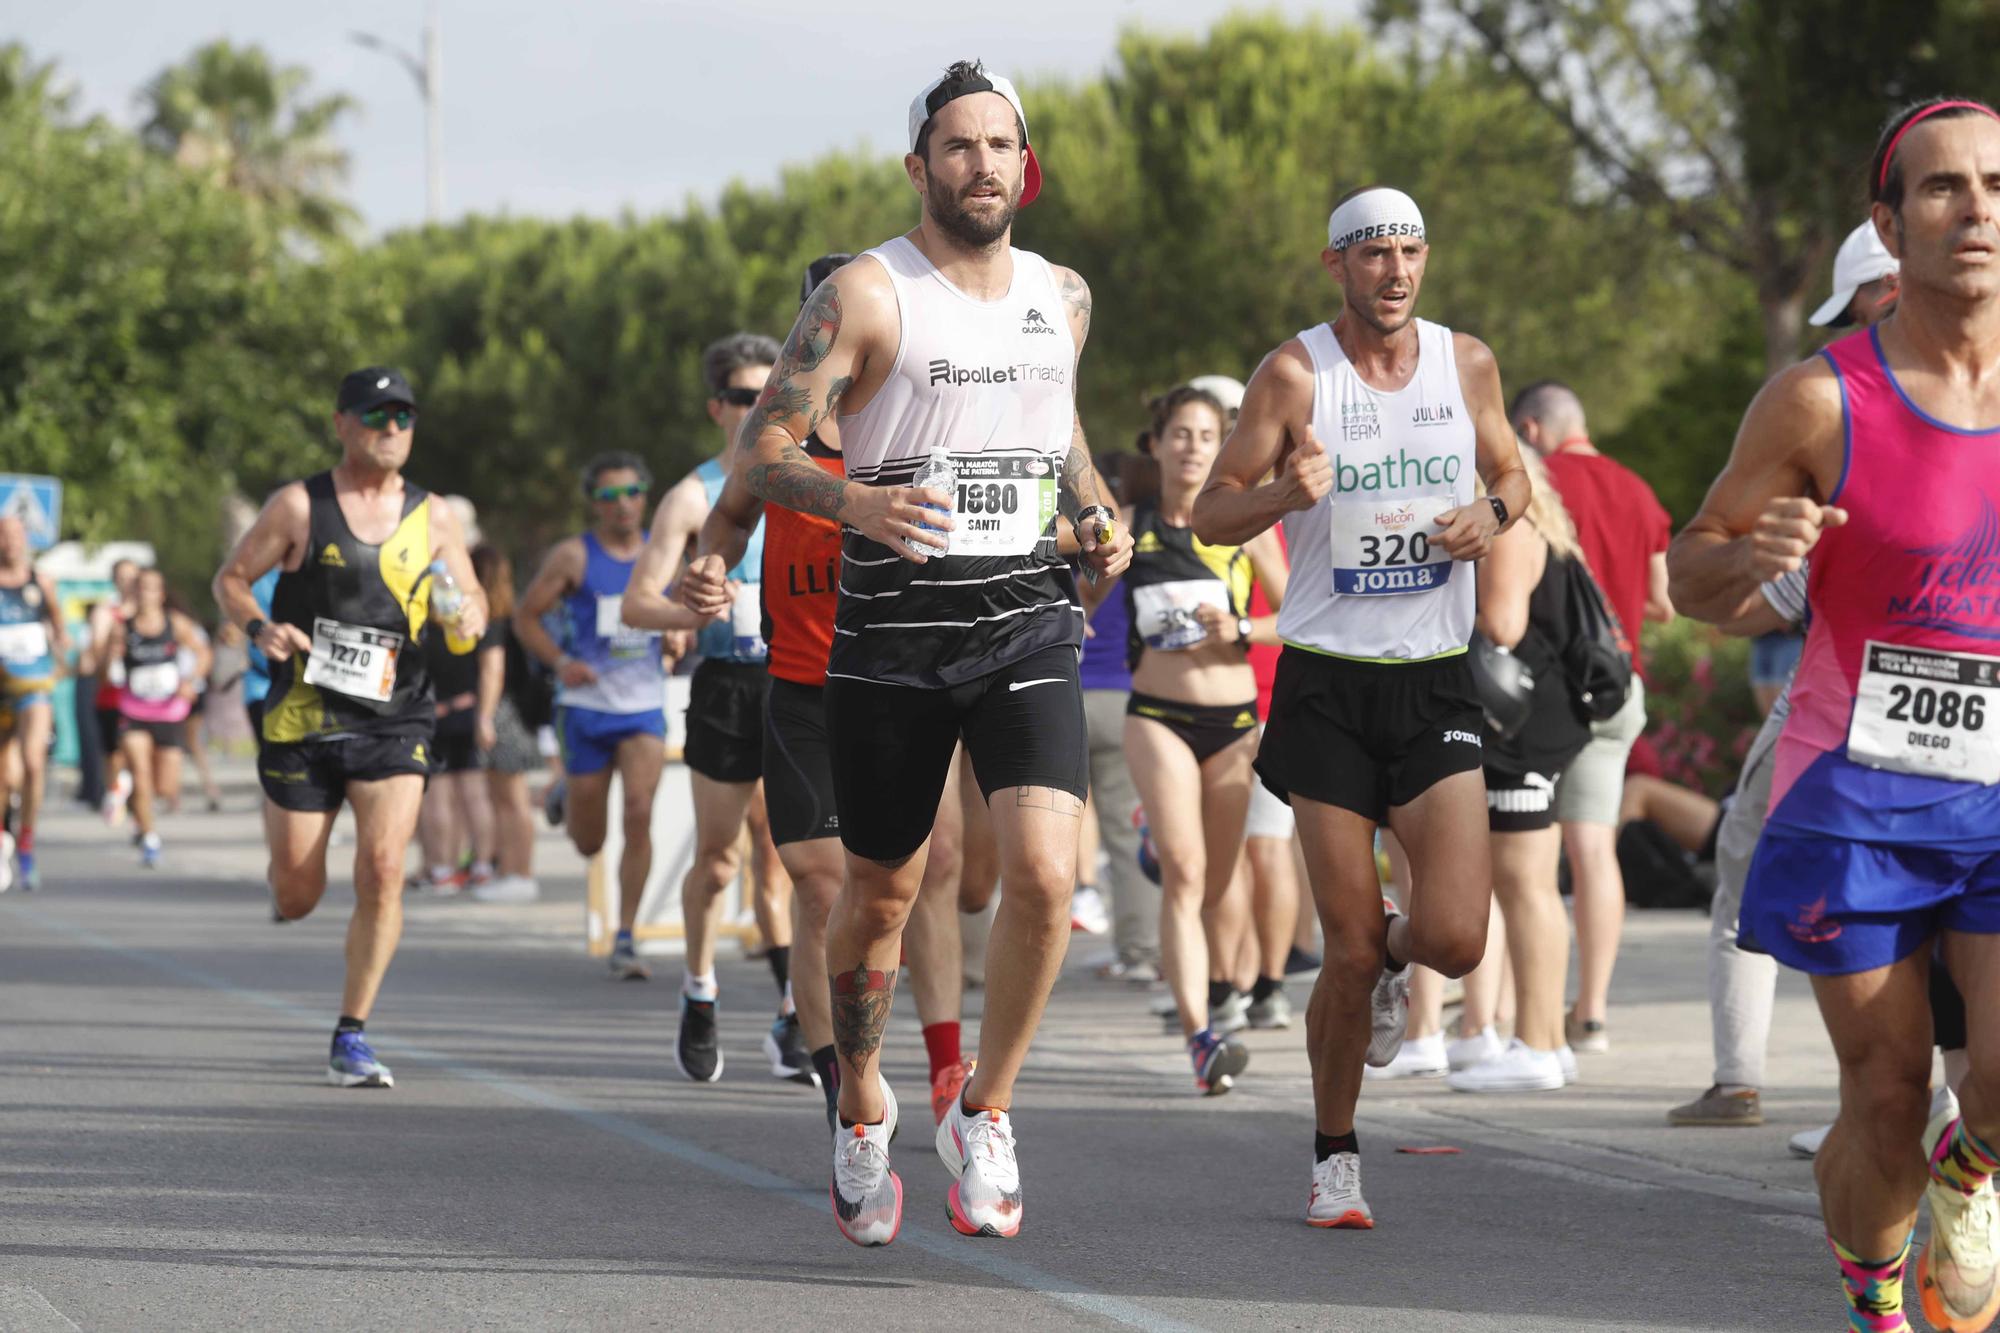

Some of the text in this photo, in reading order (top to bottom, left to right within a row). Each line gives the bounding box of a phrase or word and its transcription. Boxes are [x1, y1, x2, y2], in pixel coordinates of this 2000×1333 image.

[1412, 403, 1453, 422] JULIÁN
[1342, 424, 1381, 442] TEAM
[966, 459, 999, 468] MARATÓN
[971, 468, 1000, 476] PATERNA
[1336, 448, 1461, 493] bathco
[957, 483, 1018, 514] 1880
[968, 519, 1000, 531] SANTI
[1360, 532, 1430, 567] 320
[331, 642, 371, 668] 1270
[1886, 684, 1986, 731] 2086
[1908, 731, 1951, 749] DIEGO
